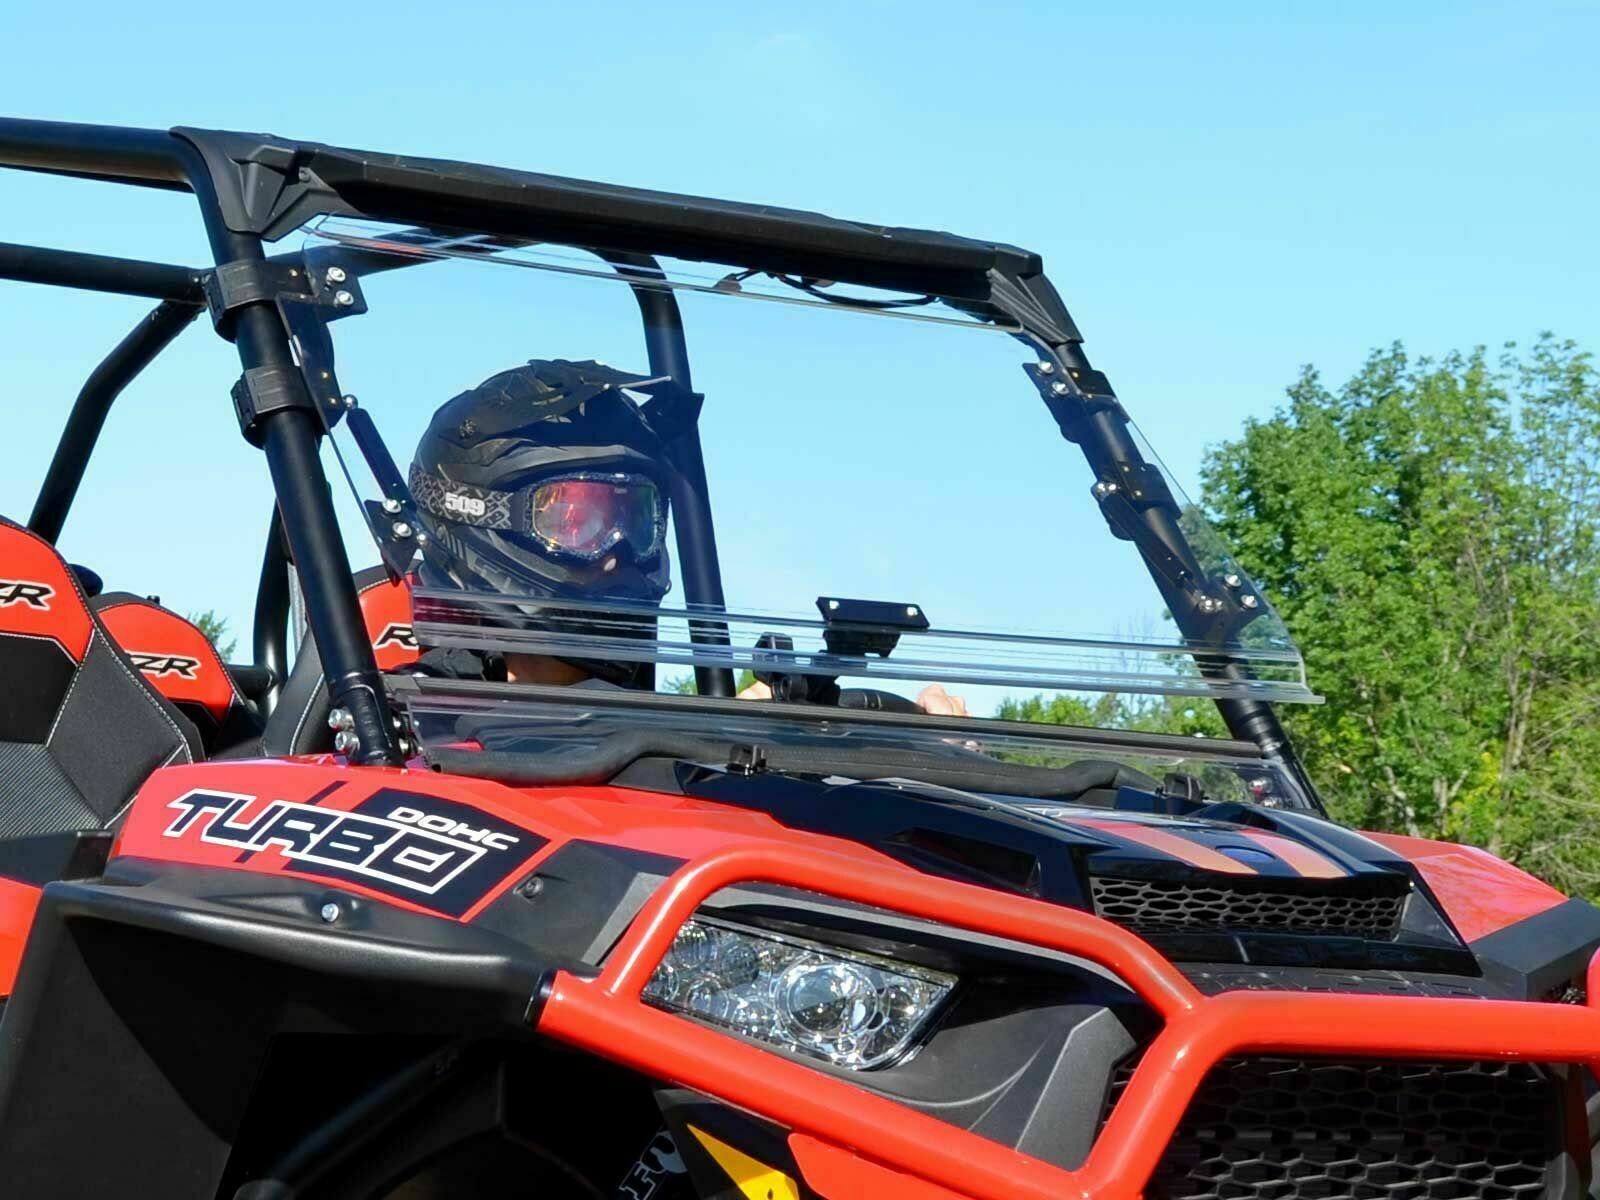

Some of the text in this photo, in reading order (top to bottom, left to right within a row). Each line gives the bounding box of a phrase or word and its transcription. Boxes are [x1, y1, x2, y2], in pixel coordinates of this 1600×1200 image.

[445, 492, 485, 516] 509
[163, 787, 489, 895] TURBO
[386, 805, 520, 851] DOHC
